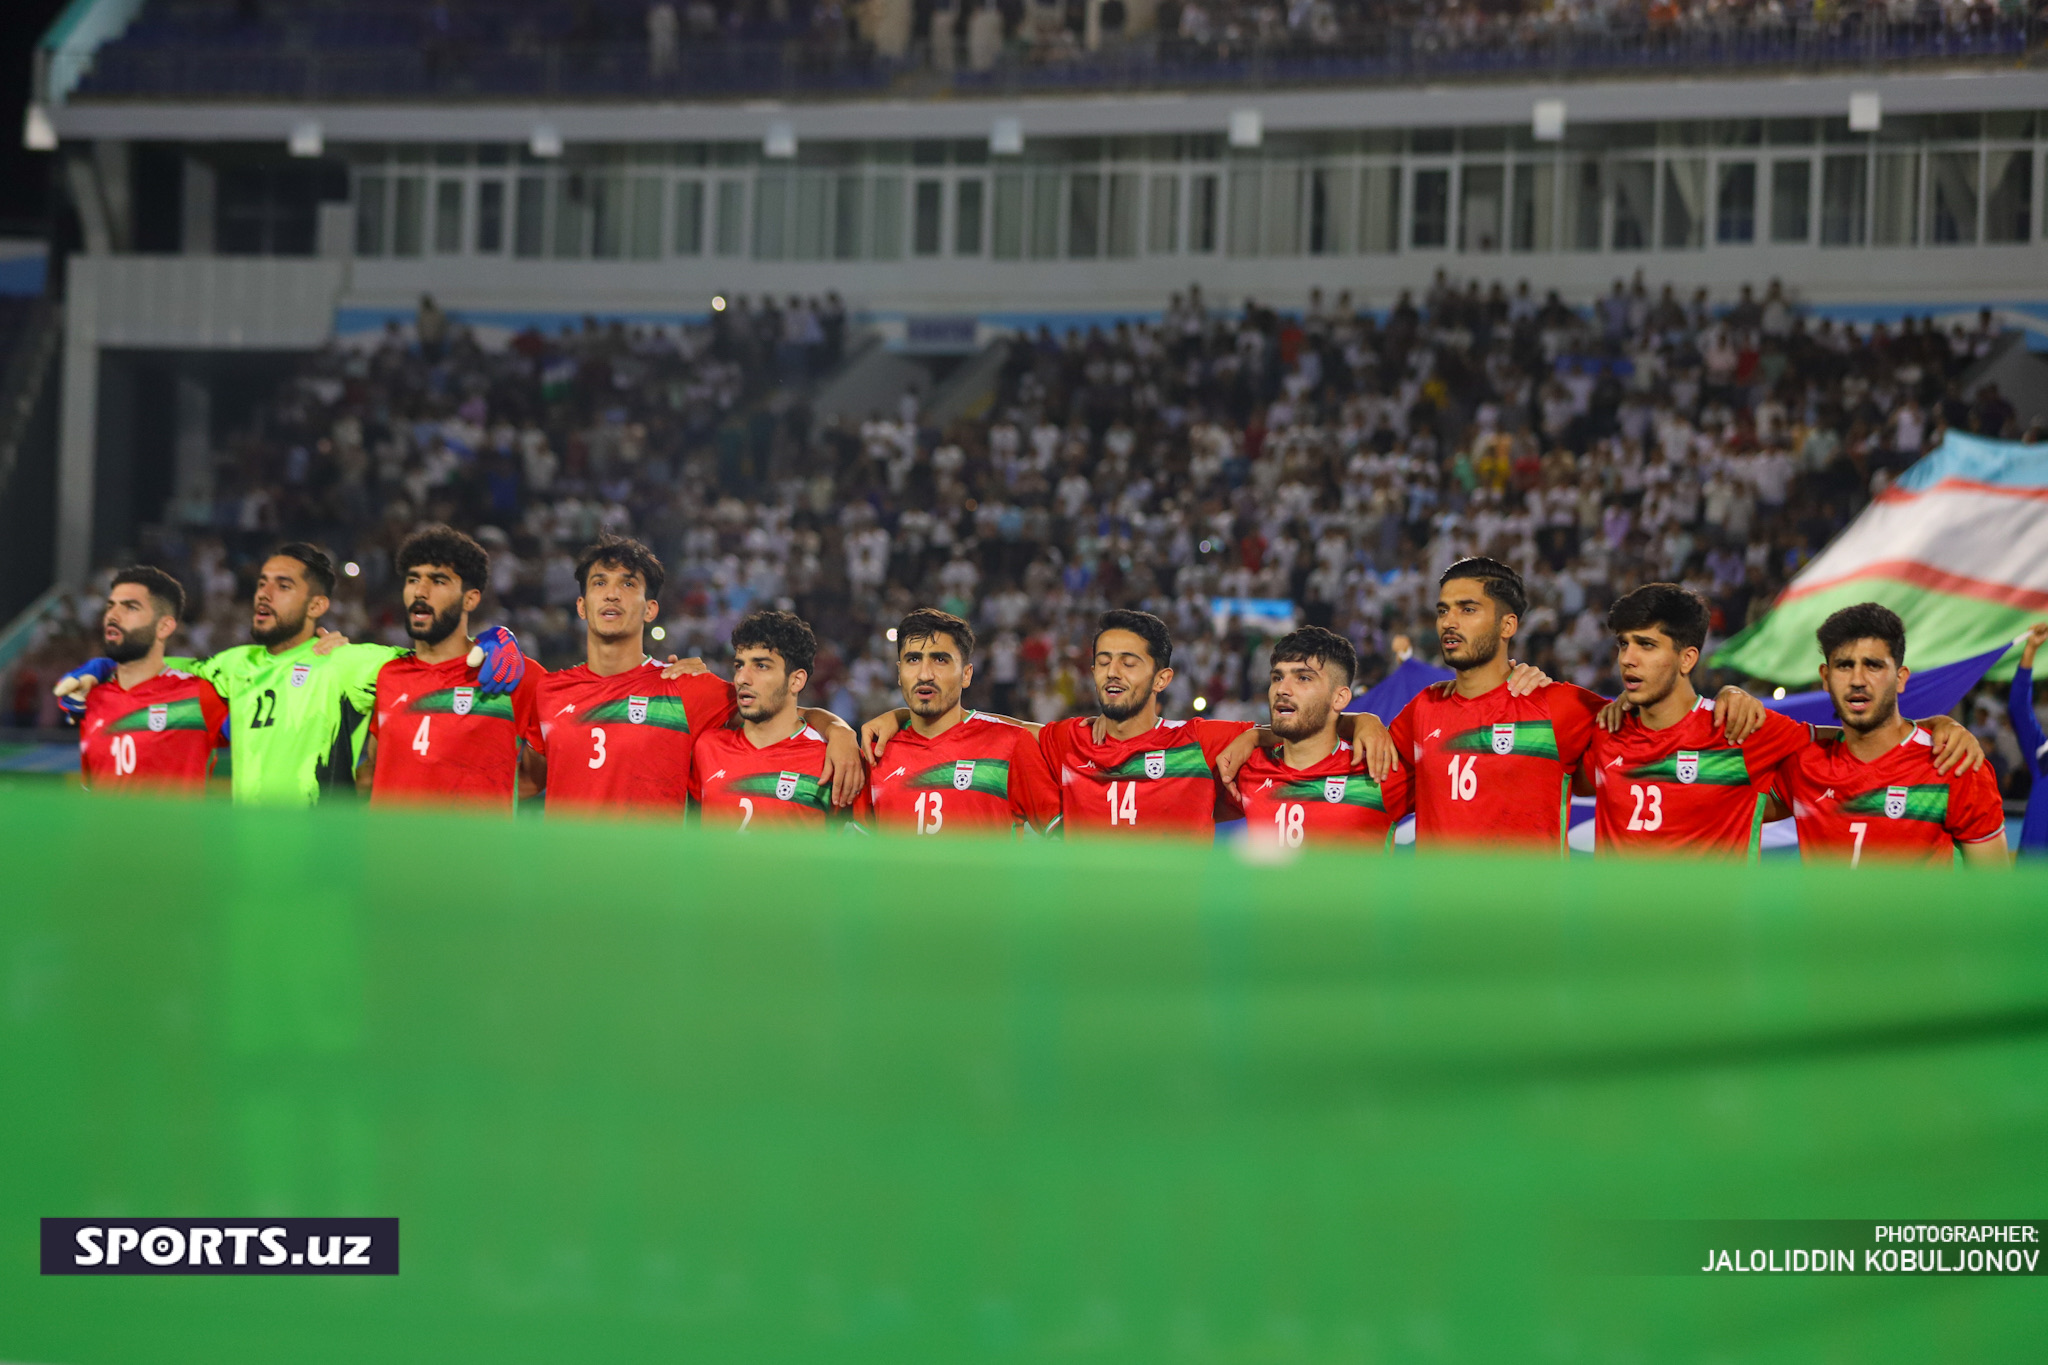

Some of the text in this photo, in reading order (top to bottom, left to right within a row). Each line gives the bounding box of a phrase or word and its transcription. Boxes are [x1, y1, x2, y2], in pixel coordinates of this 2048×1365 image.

[250, 689, 276, 729] 22
[110, 734, 137, 776] 10
[412, 715, 431, 756] 4
[588, 727, 607, 770] 3
[1447, 755, 1477, 801] 16
[914, 791, 943, 835] 13
[1106, 781, 1137, 826] 14
[1274, 803, 1305, 848] 18
[1626, 784, 1663, 832] 23
[1848, 822, 1867, 869] 7
